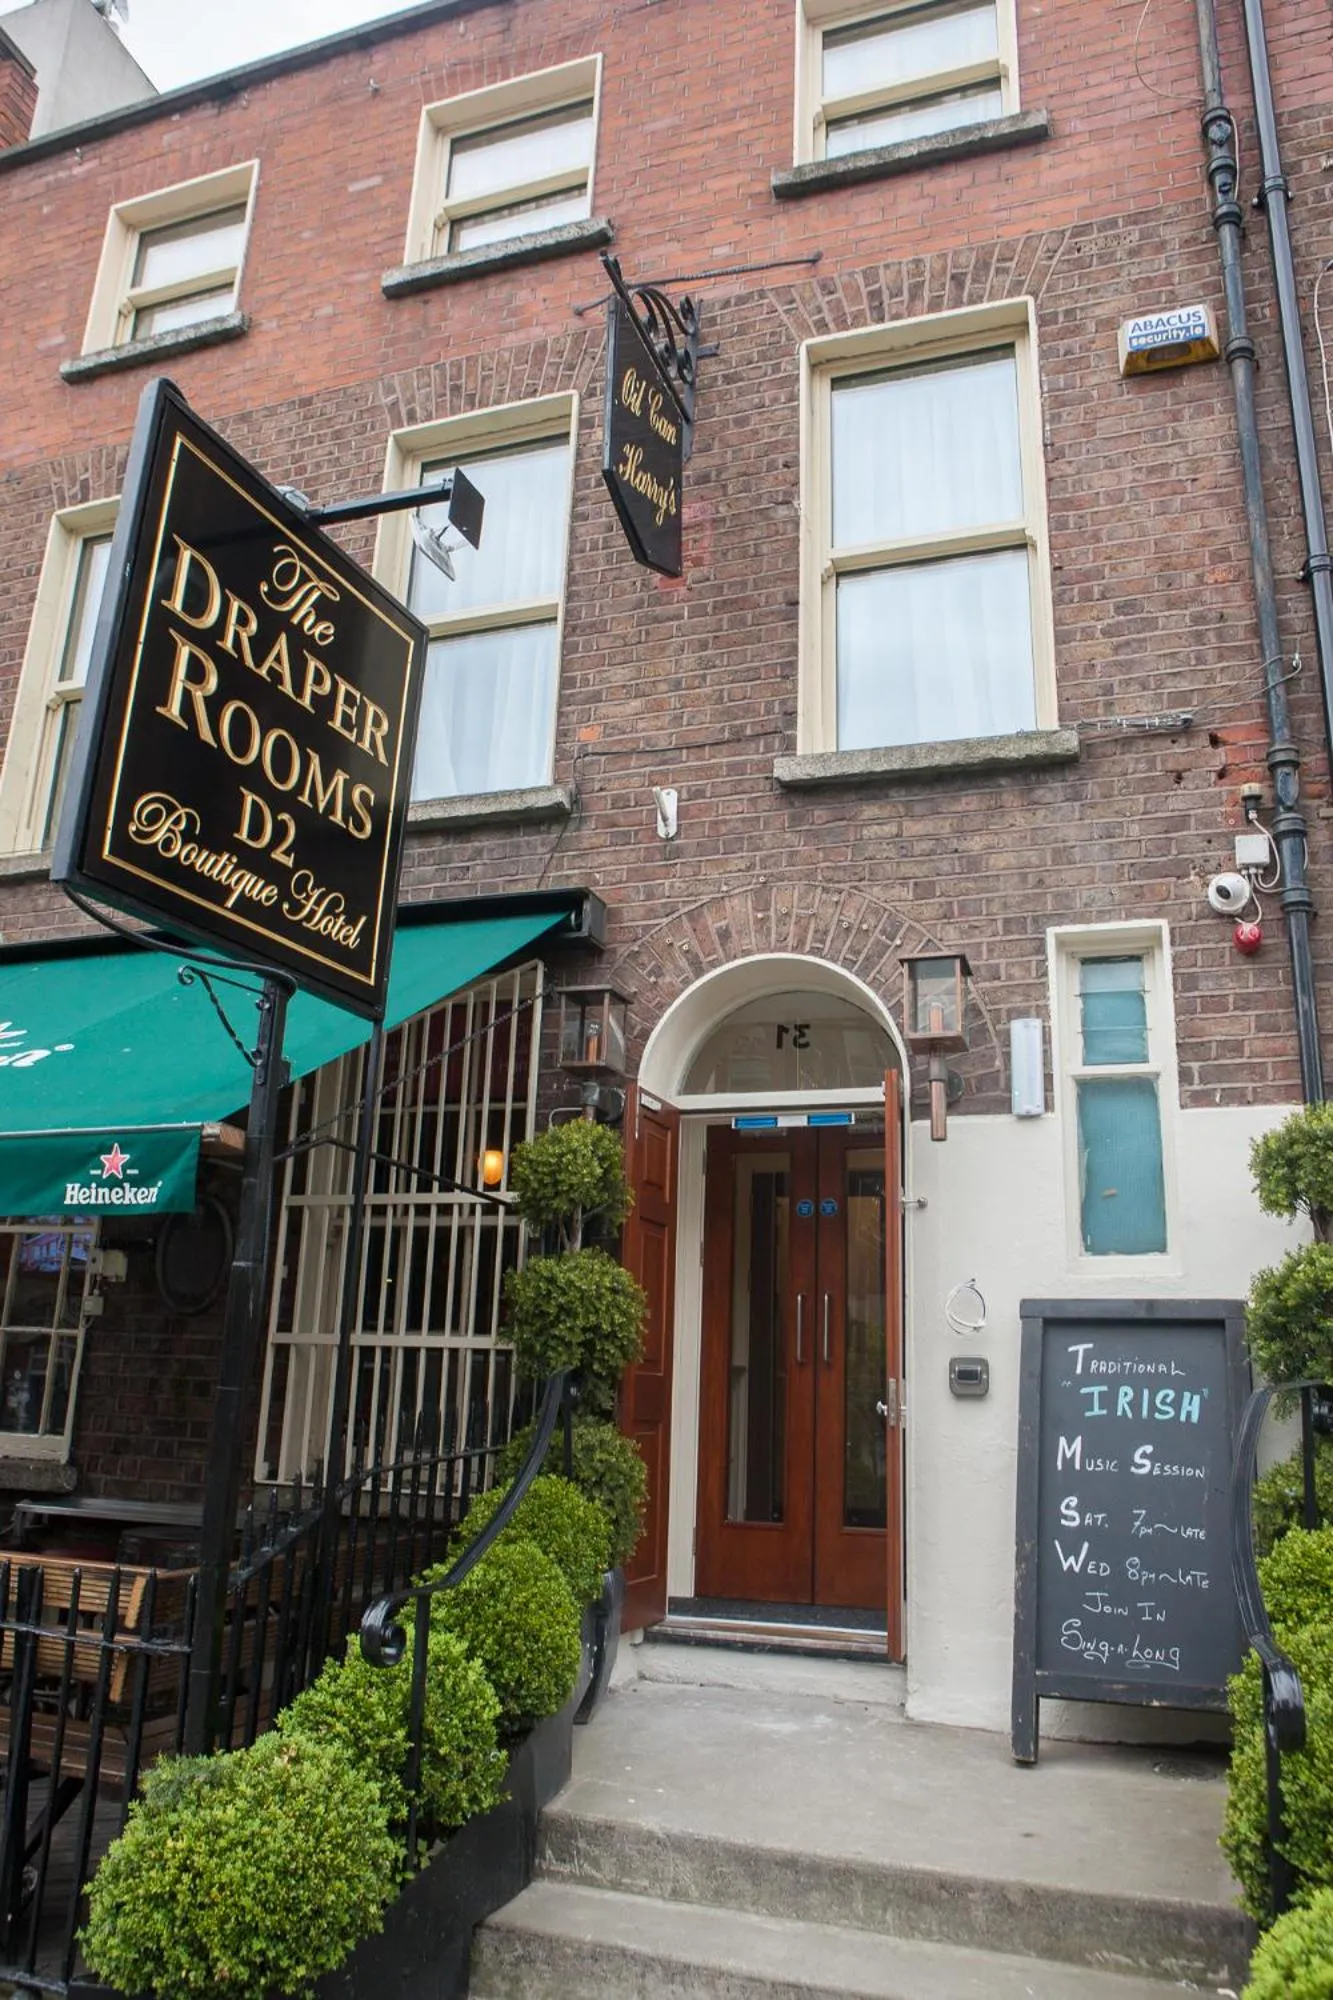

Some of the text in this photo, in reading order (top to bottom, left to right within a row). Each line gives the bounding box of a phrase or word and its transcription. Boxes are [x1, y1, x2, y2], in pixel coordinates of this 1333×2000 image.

[1131, 310, 1202, 334] ABACUS
[621, 367, 677, 446] Oil Can
[619, 444, 677, 527] Harry's
[260, 544, 341, 647] The
[161, 532, 391, 767] DRAPER
[155, 626, 376, 841] ROOMS
[233, 786, 297, 869] D2
[128, 790, 364, 951] Boutique Hotel
[63, 1181, 163, 1206] Heineken
[1067, 1342, 1187, 1377] TRADITIONAL
[1056, 1434, 1206, 1479] MUSIC SESSION
[1054, 1539, 1111, 1577] WED
[1082, 1591, 1167, 1623] JOIN IN
